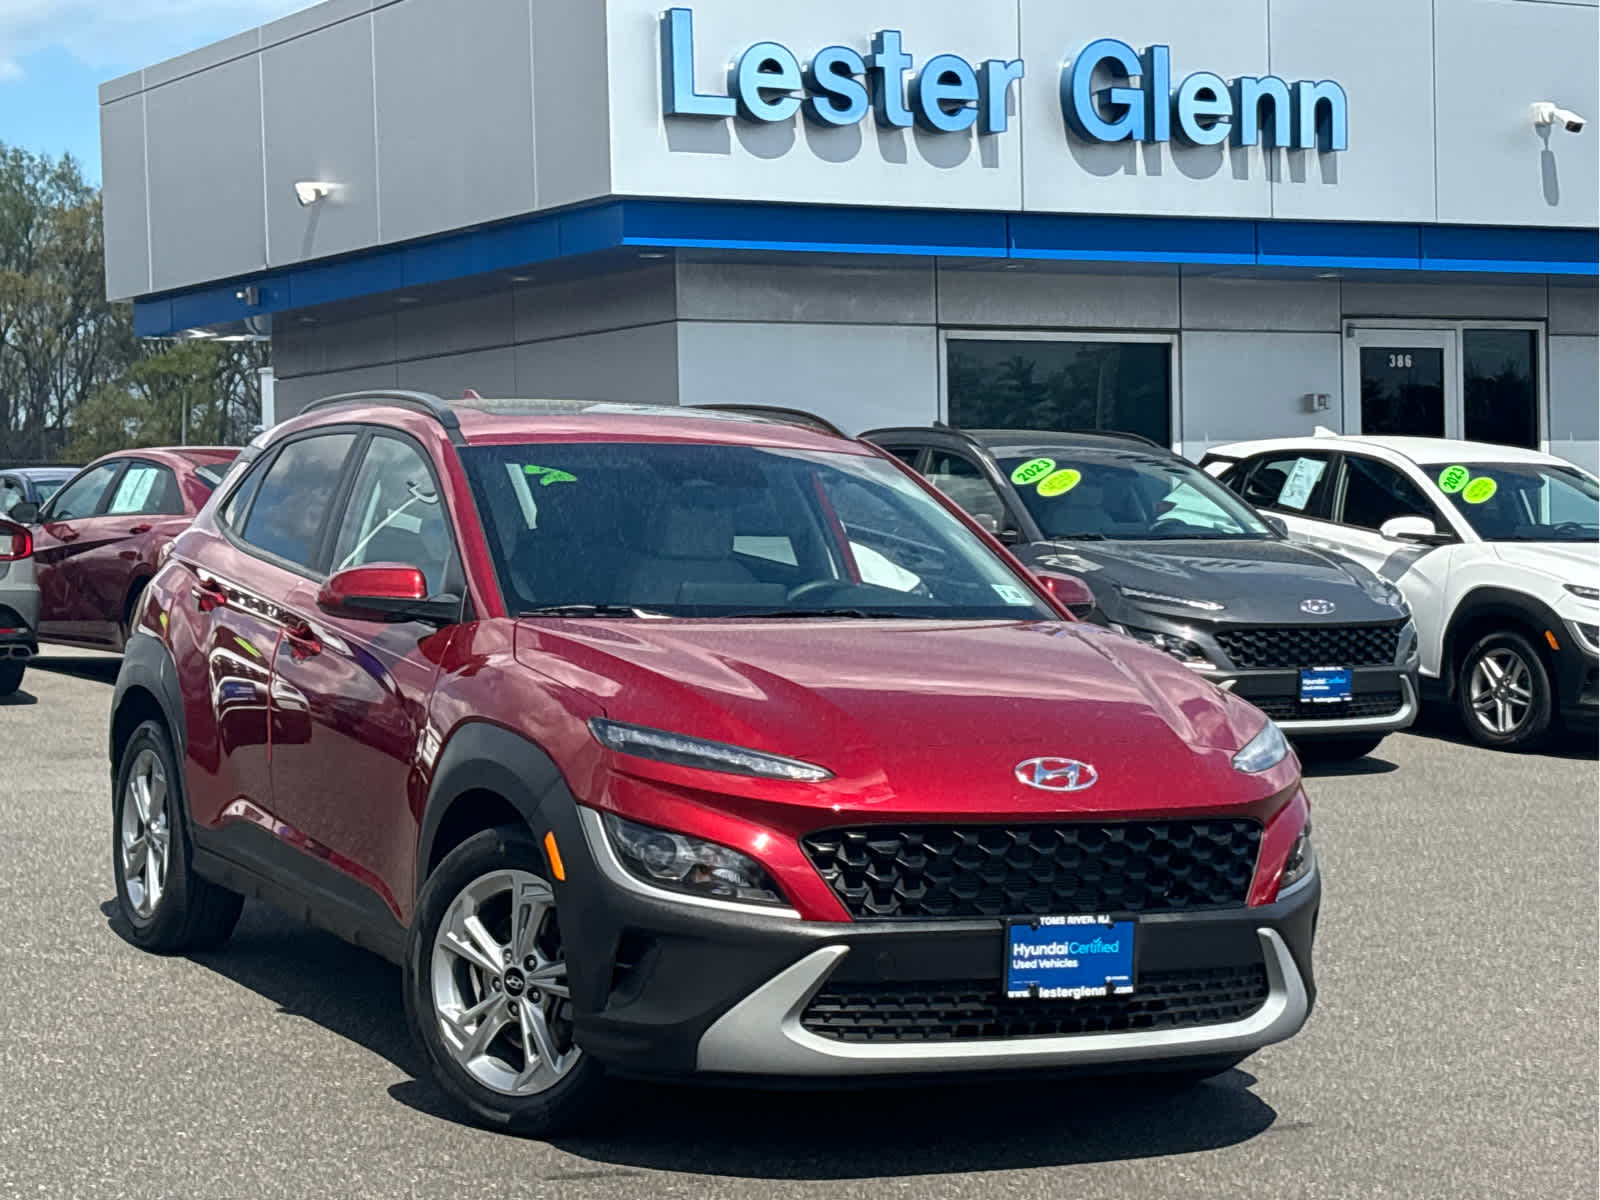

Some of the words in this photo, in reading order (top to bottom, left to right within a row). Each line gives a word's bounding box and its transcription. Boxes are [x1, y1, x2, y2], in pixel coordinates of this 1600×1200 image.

[659, 7, 1025, 134] Lester
[1061, 38, 1349, 152] Glenn
[1389, 354, 1412, 368] 386
[1016, 459, 1052, 482] 2023
[1443, 467, 1465, 490] 2023
[1040, 916, 1066, 926] TOMS
[1013, 958, 1037, 969] Used
[1038, 958, 1079, 969] Vehicles
[1038, 985, 1107, 1000] lesterglenn
